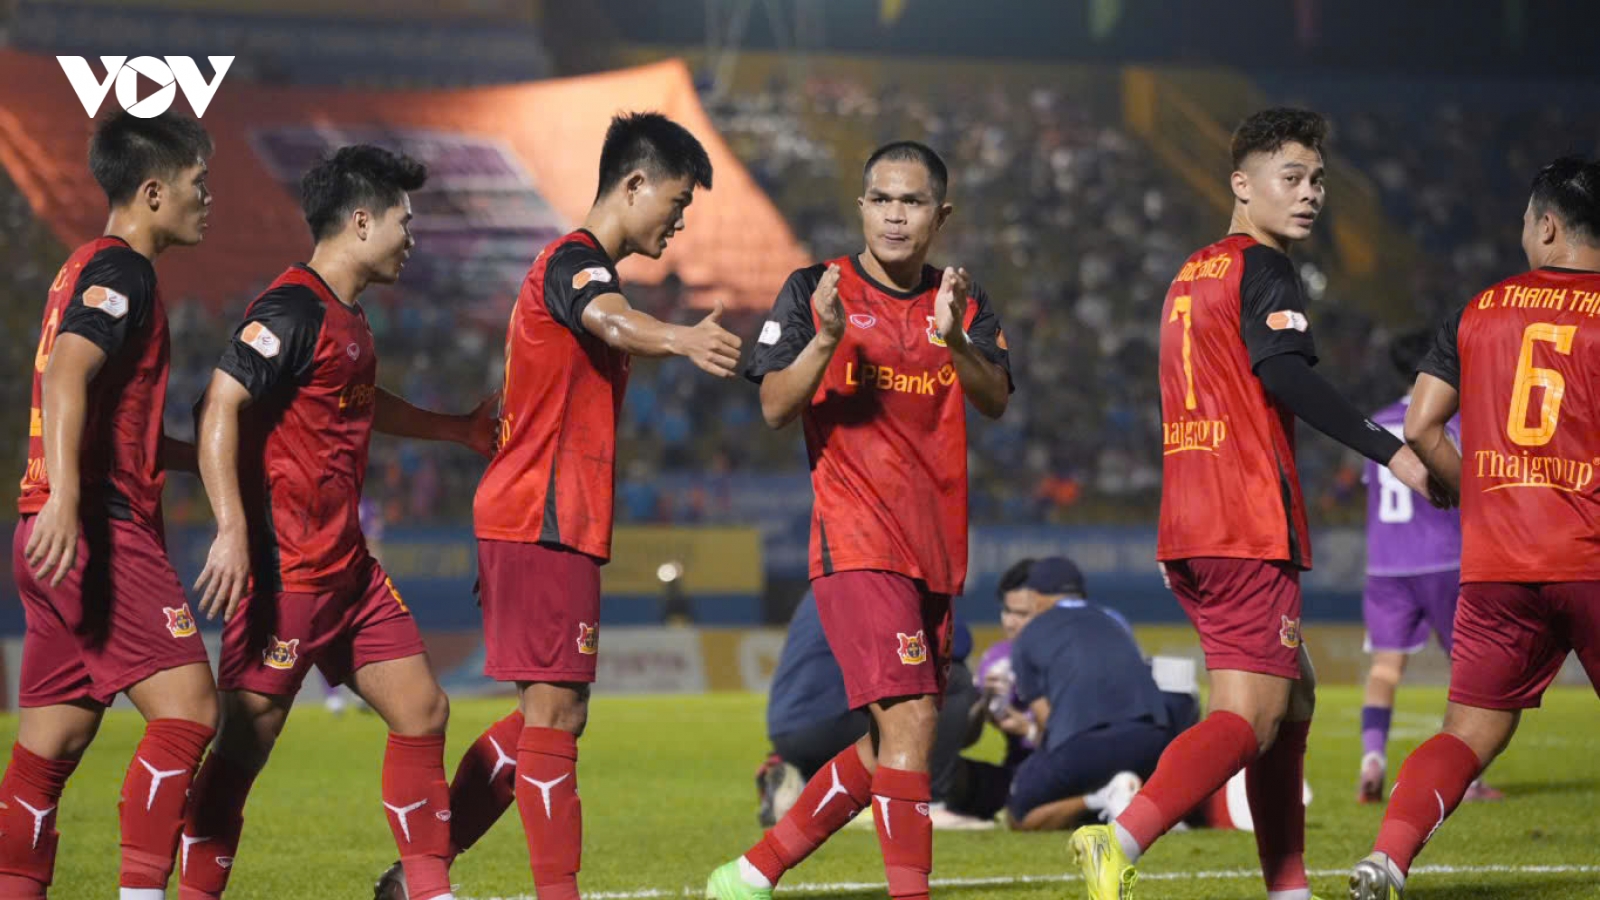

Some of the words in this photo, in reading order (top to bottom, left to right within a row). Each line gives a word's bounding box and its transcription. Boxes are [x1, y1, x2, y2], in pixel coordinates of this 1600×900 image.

[1569, 290, 1600, 317] THỊ
[1169, 295, 1197, 410] 7
[846, 362, 935, 395] LPBank
[1507, 323, 1577, 446] 6
[1476, 450, 1593, 490] Thaigroup
